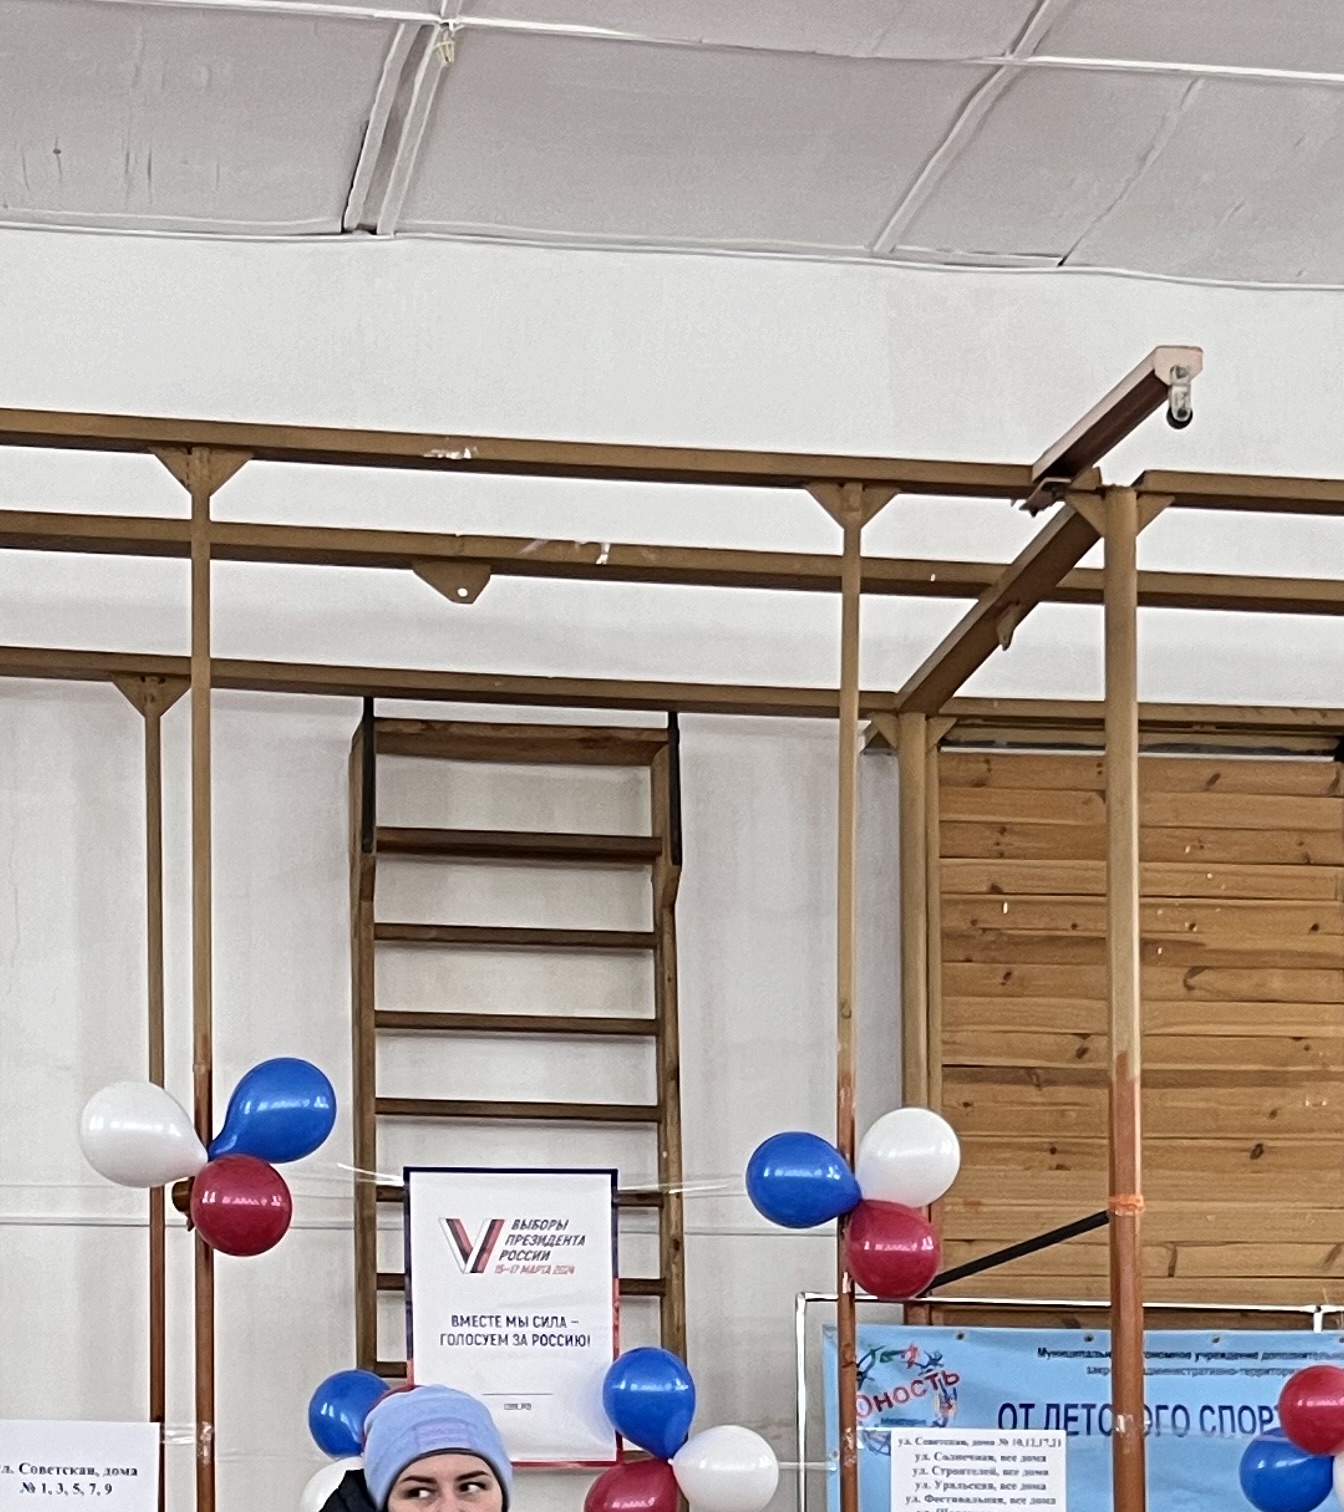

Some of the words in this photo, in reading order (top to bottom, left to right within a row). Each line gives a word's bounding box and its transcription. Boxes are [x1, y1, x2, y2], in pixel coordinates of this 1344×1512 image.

[511, 1219, 569, 1231] ВЫБОРЫ
[505, 1234, 586, 1247] ПРЕЗИДЕНТА
[499, 1250, 551, 1261] РОССИИ
[520, 1265, 551, 1274] МАРТА
[451, 1315, 501, 1328] ВМЕСТЕ
[506, 1315, 529, 1328] МЫ
[533, 1315, 567, 1328] СИЛА
[439, 1333, 508, 1347] ГОЛОСУЕМ
[513, 1334, 528, 1346] ЗА
[531, 1334, 591, 1347] РОССИЮ!
[998, 1403, 1035, 1430] ОТ
[1200, 1405, 1278, 1434] СПОР
[19, 1462, 99, 1477] Советская,
[103, 1467, 138, 1477] дома
[56, 1483, 69, 1496] 3,
[72, 1483, 85, 1496] 5,
[89, 1483, 101, 1496] 7,
[104, 1483, 113, 1495] 9
